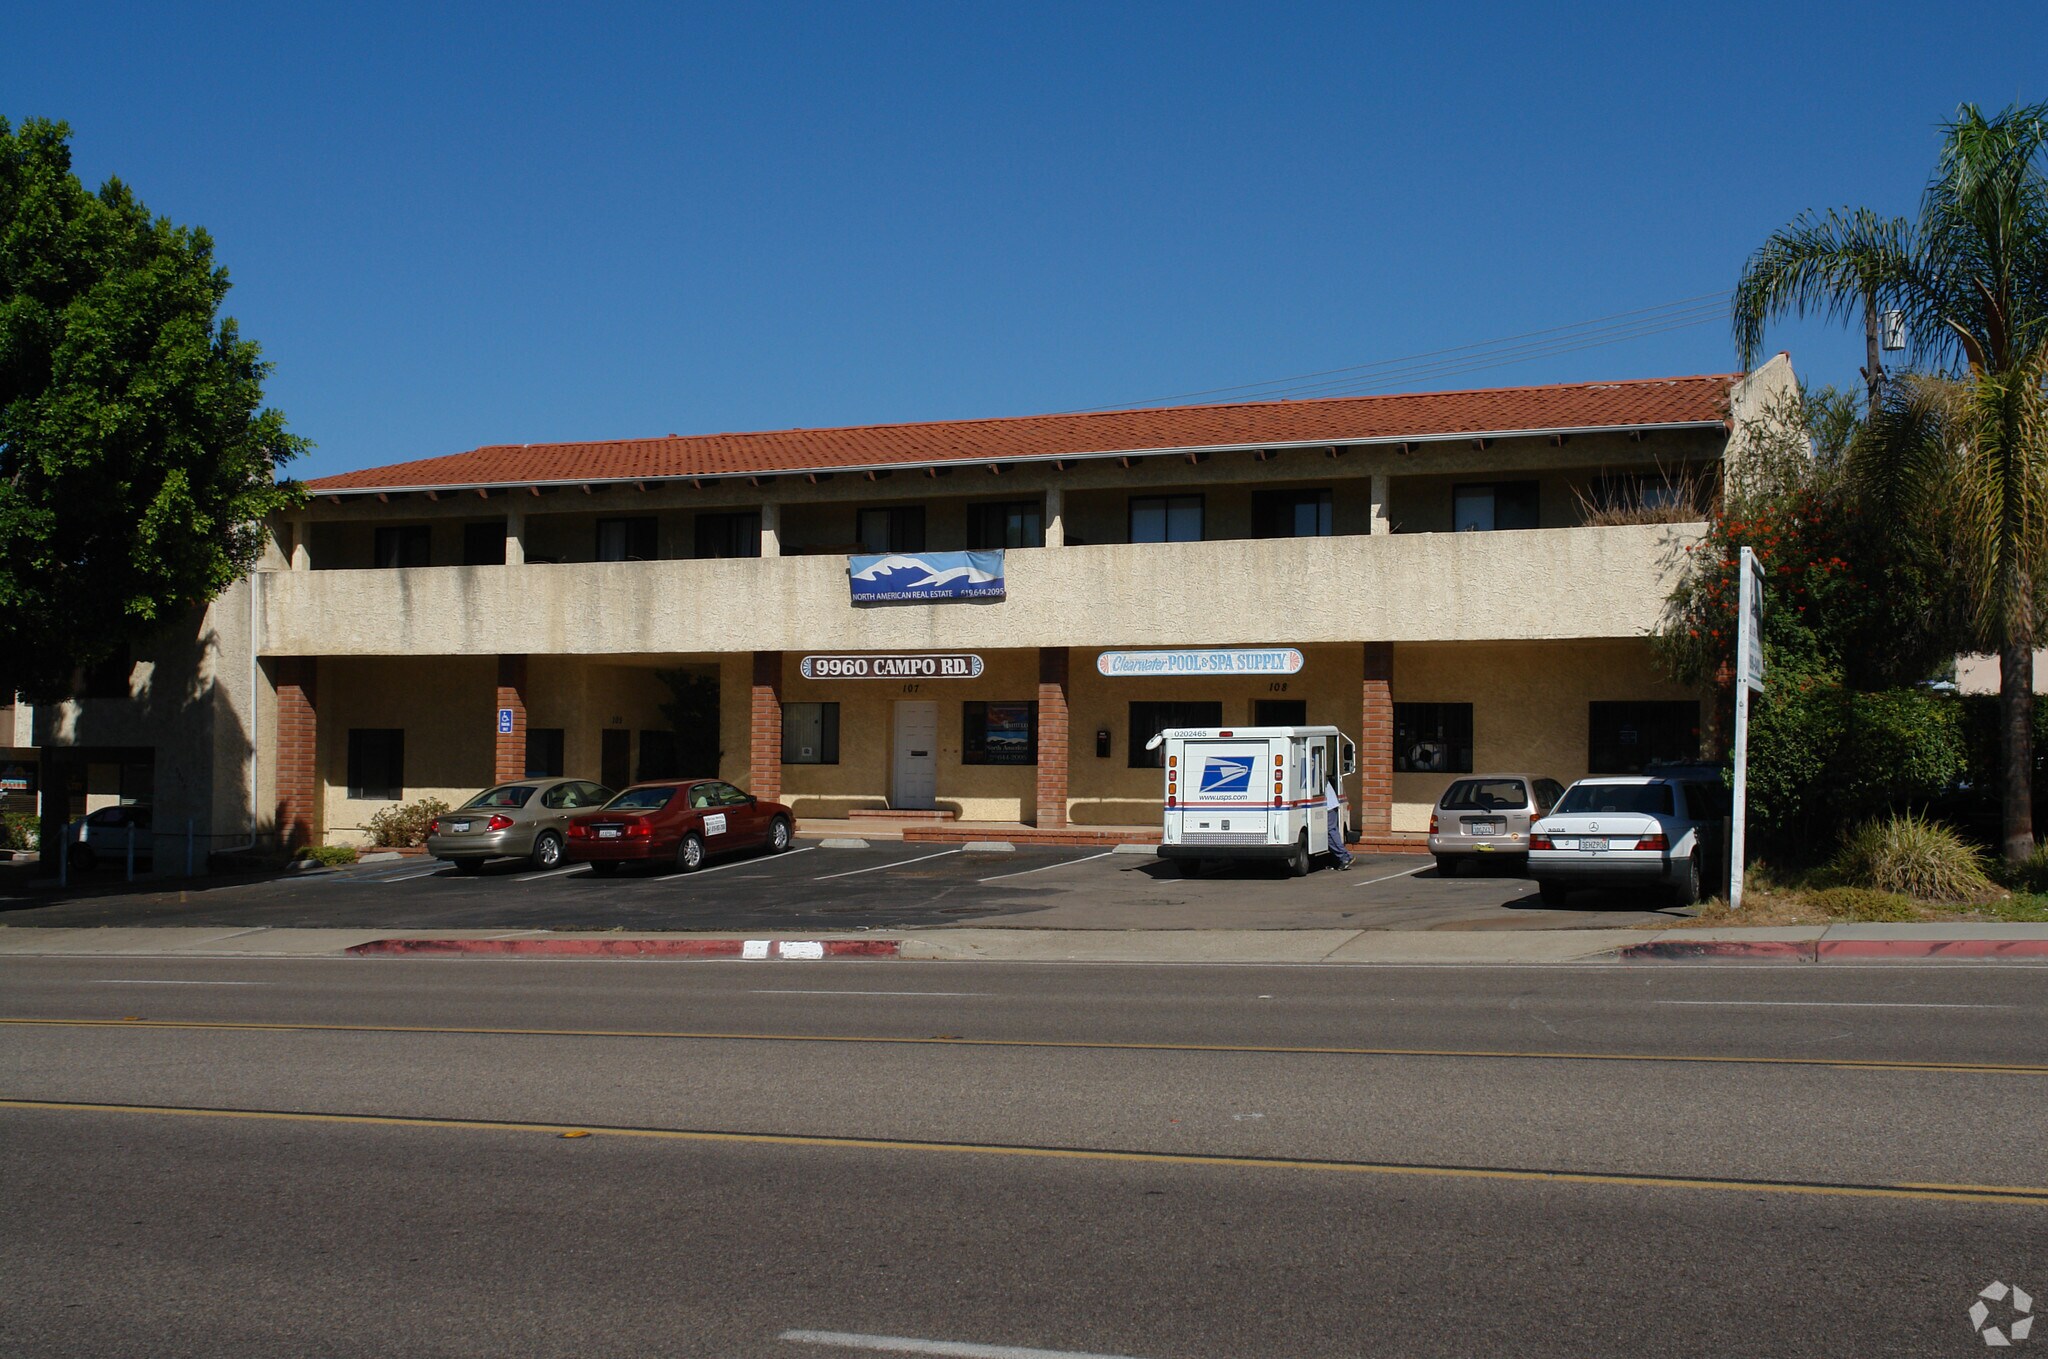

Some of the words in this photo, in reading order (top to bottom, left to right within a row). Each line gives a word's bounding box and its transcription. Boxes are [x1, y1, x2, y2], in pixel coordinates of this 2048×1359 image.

[853, 593, 875, 601] NORTH
[876, 592, 911, 600] AMERICAN
[912, 591, 929, 599] REAL
[930, 590, 953, 598] ESTATE
[816, 659, 868, 676] 9960
[873, 658, 936, 675] CAMPO
[940, 658, 969, 675] RD.
[1112, 655, 1168, 672] Clearwater
[1167, 655, 1202, 671] POOL
[1209, 654, 1234, 671] SPA
[1237, 653, 1287, 670] SUPPLY
[903, 684, 920, 693] 107
[1268, 682, 1288, 692] 108
[1174, 730, 1207, 738] 0202465
